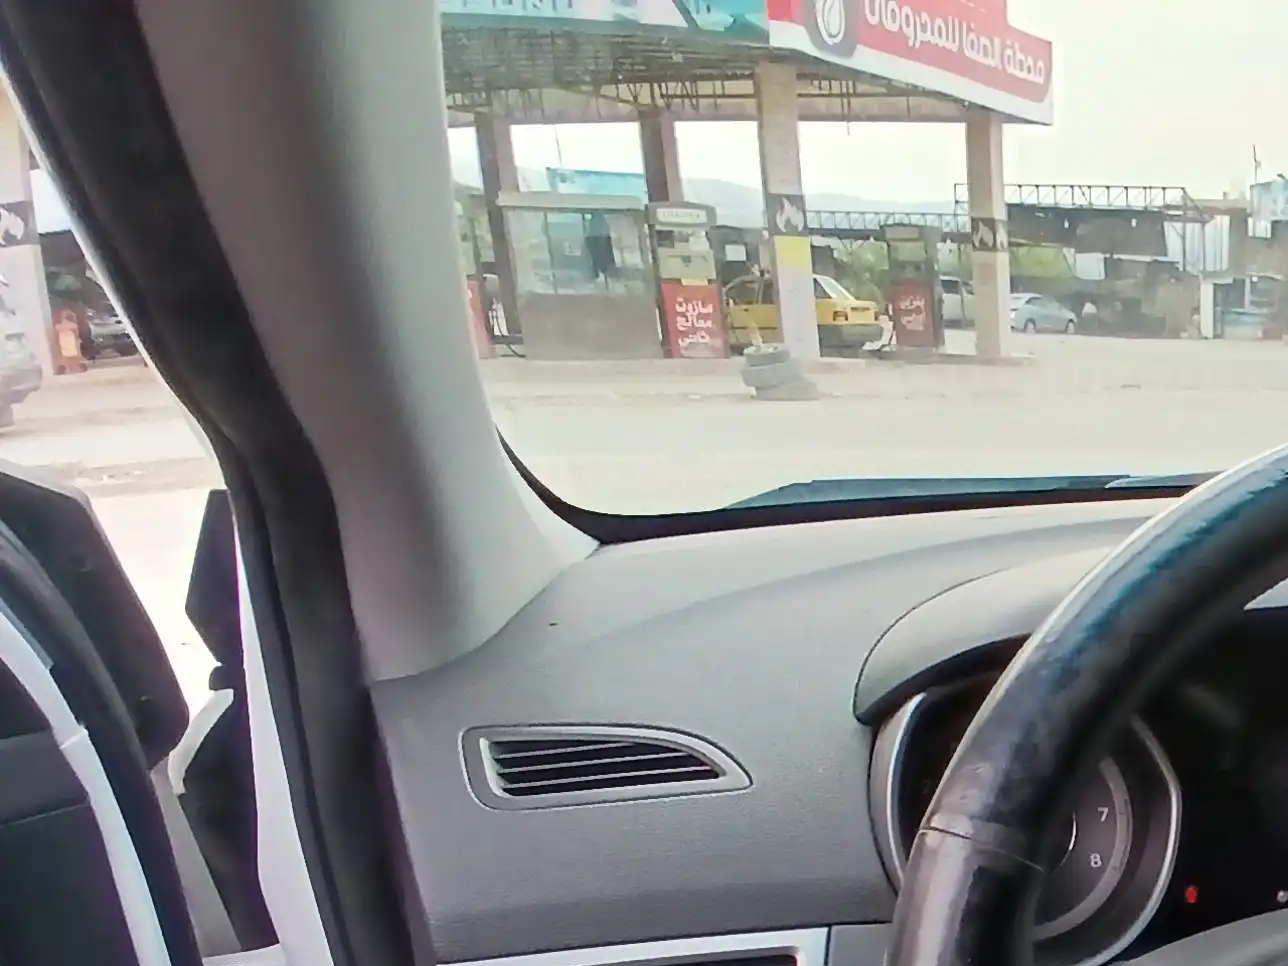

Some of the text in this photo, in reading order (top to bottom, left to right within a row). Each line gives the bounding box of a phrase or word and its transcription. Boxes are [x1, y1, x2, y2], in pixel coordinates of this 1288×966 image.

[961, 20, 1003, 70] الصفا
[1004, 40, 1045, 85] محطة
[1097, 806, 1109, 822] 7
[1090, 853, 1102, 868] 8
